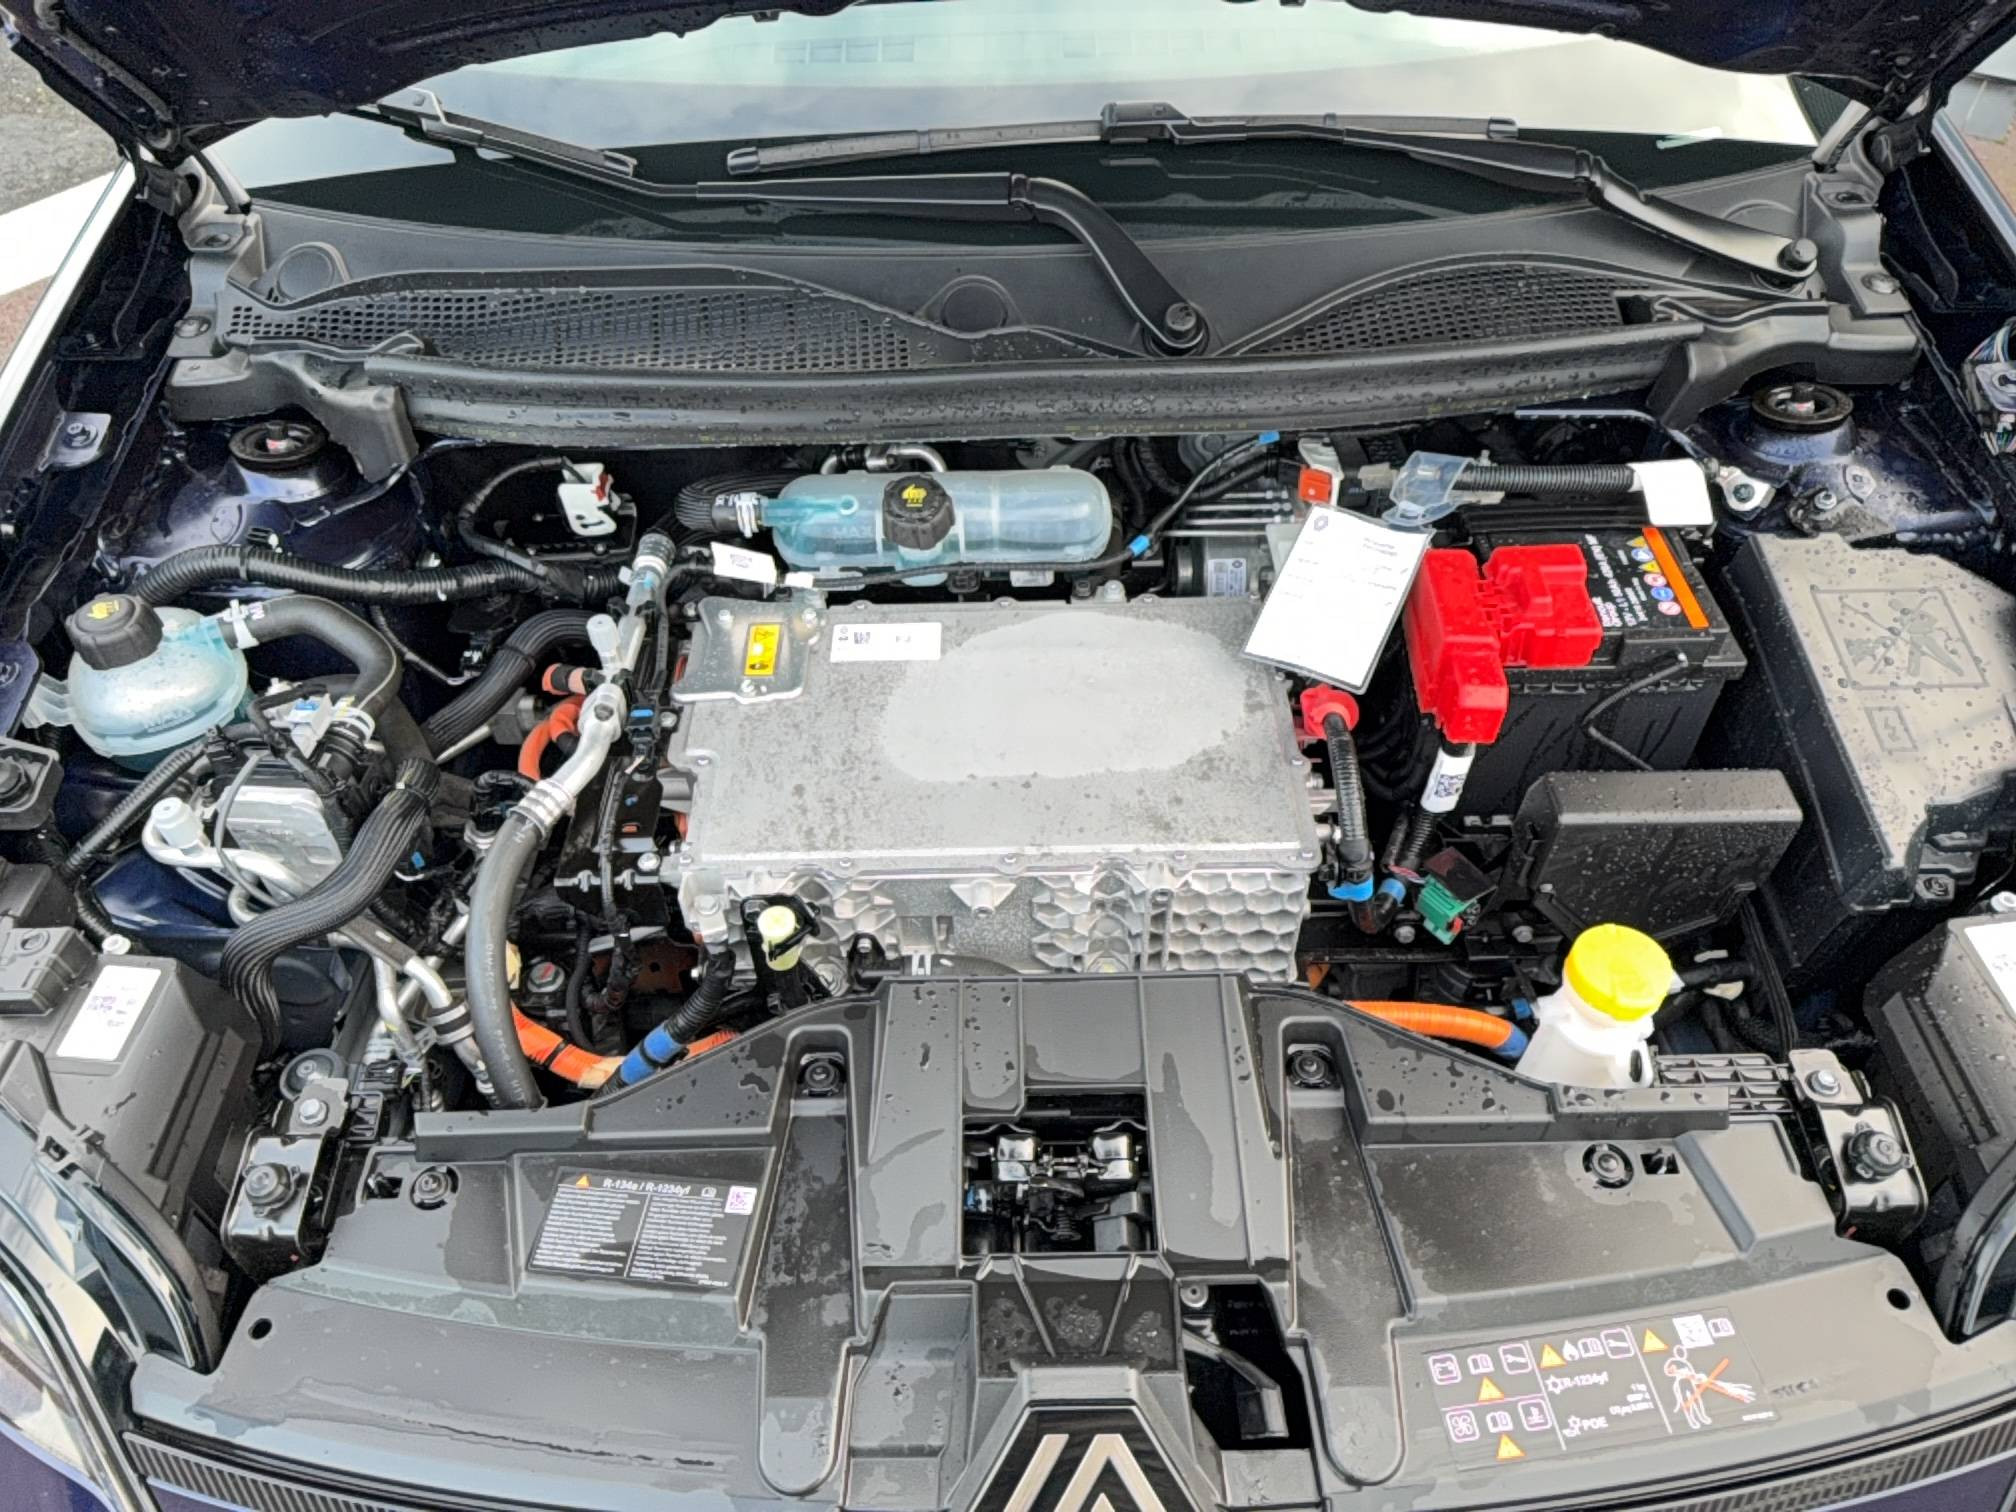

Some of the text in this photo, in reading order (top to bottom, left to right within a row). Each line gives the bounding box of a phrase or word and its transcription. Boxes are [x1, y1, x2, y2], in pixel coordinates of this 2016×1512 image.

[602, 1177, 638, 1191] R-134a
[646, 1182, 692, 1197] R-1234yf
[1560, 1371, 1609, 1389] R-1234yf
[1581, 1416, 1609, 1431] POE
